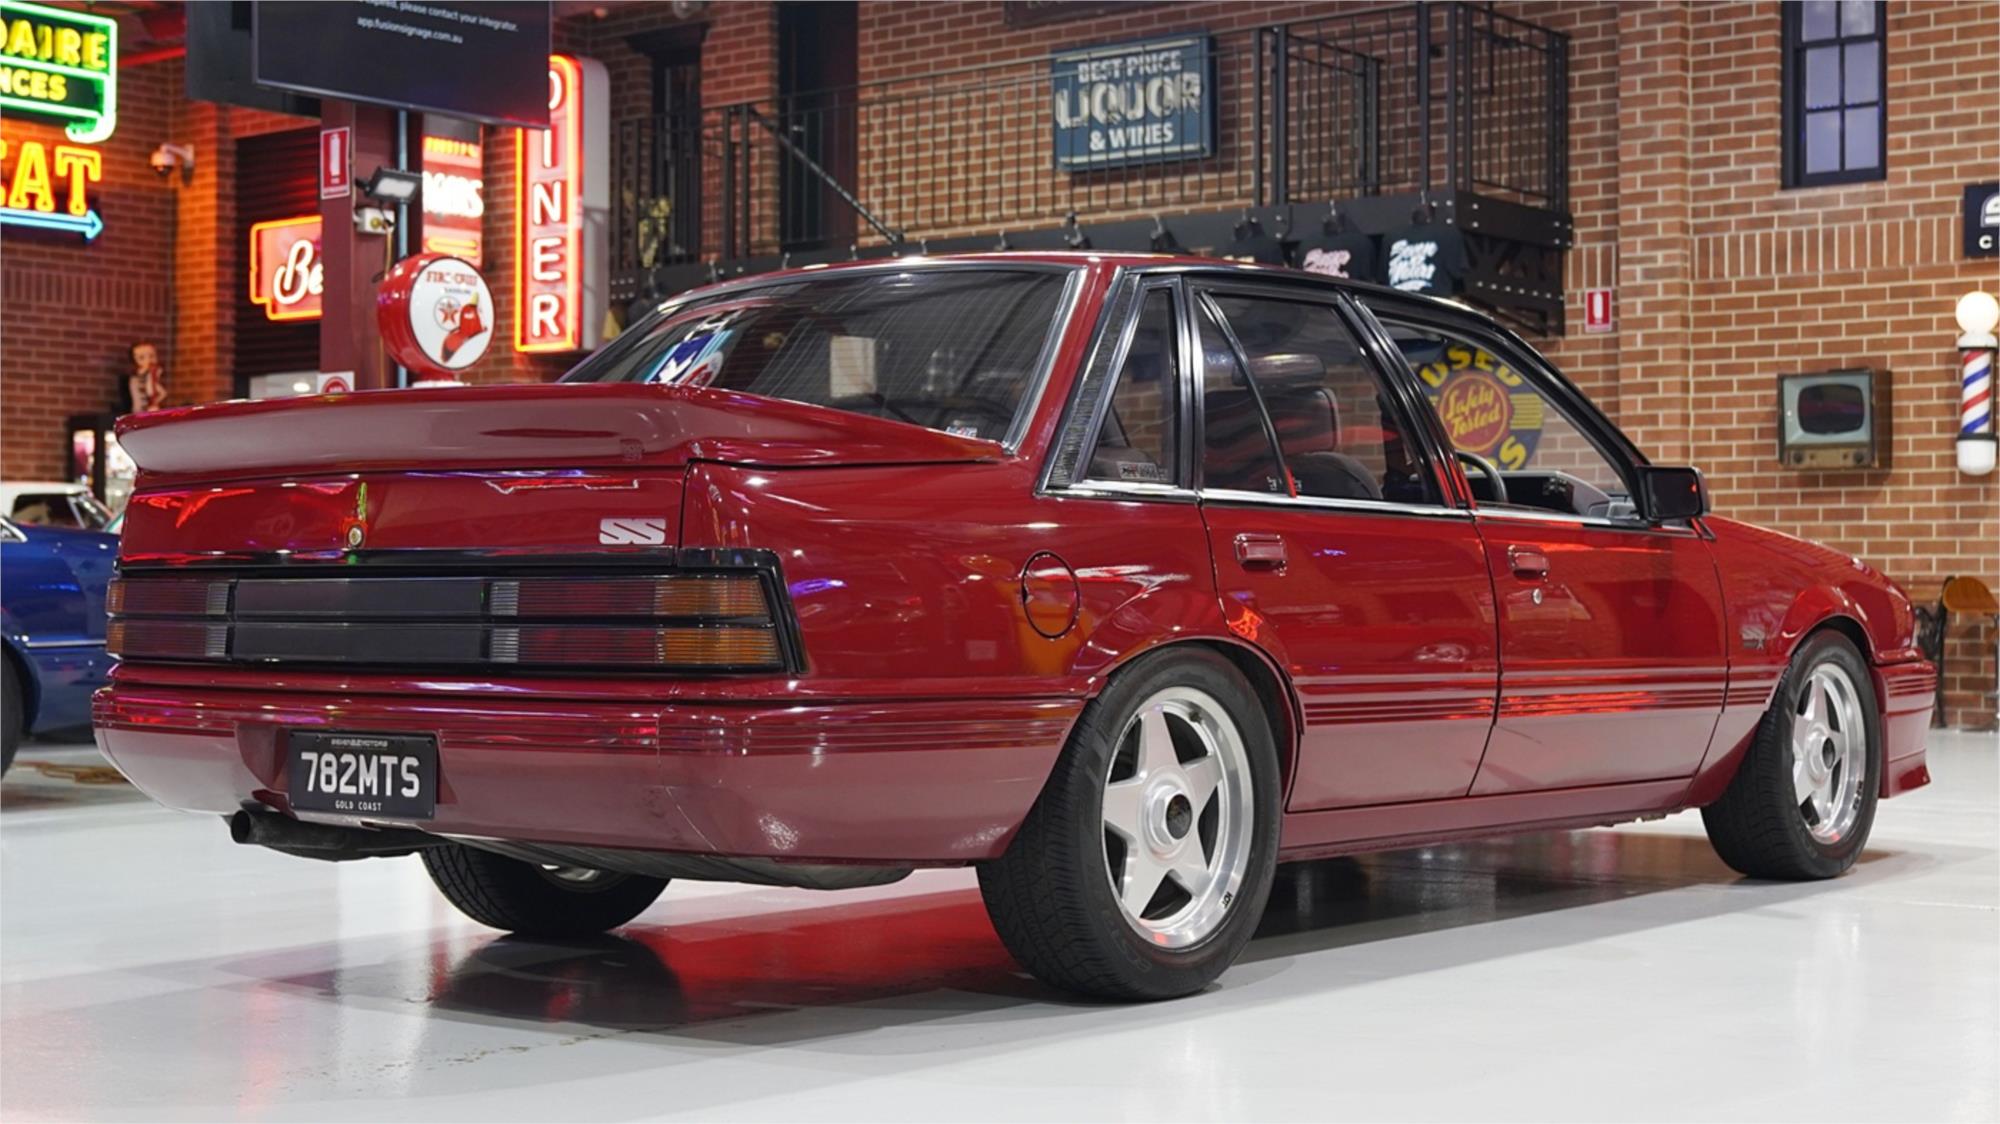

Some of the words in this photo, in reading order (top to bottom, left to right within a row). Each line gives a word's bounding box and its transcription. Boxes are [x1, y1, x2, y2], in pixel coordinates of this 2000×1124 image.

[400, 1, 427, 14] please
[428, 7, 458, 21] contact
[460, 13, 478, 24] your
[479, 16, 519, 32] integrator.
[1077, 57, 1123, 84] BEST
[1126, 50, 1182, 78] PRICE
[1089, 130, 1104, 151] &
[1107, 122, 1174, 149] WINES
[599, 518, 666, 545] SS
[301, 751, 420, 798] 782MTS
[335, 800, 354, 810] GOLD
[358, 801, 382, 812] COAST
